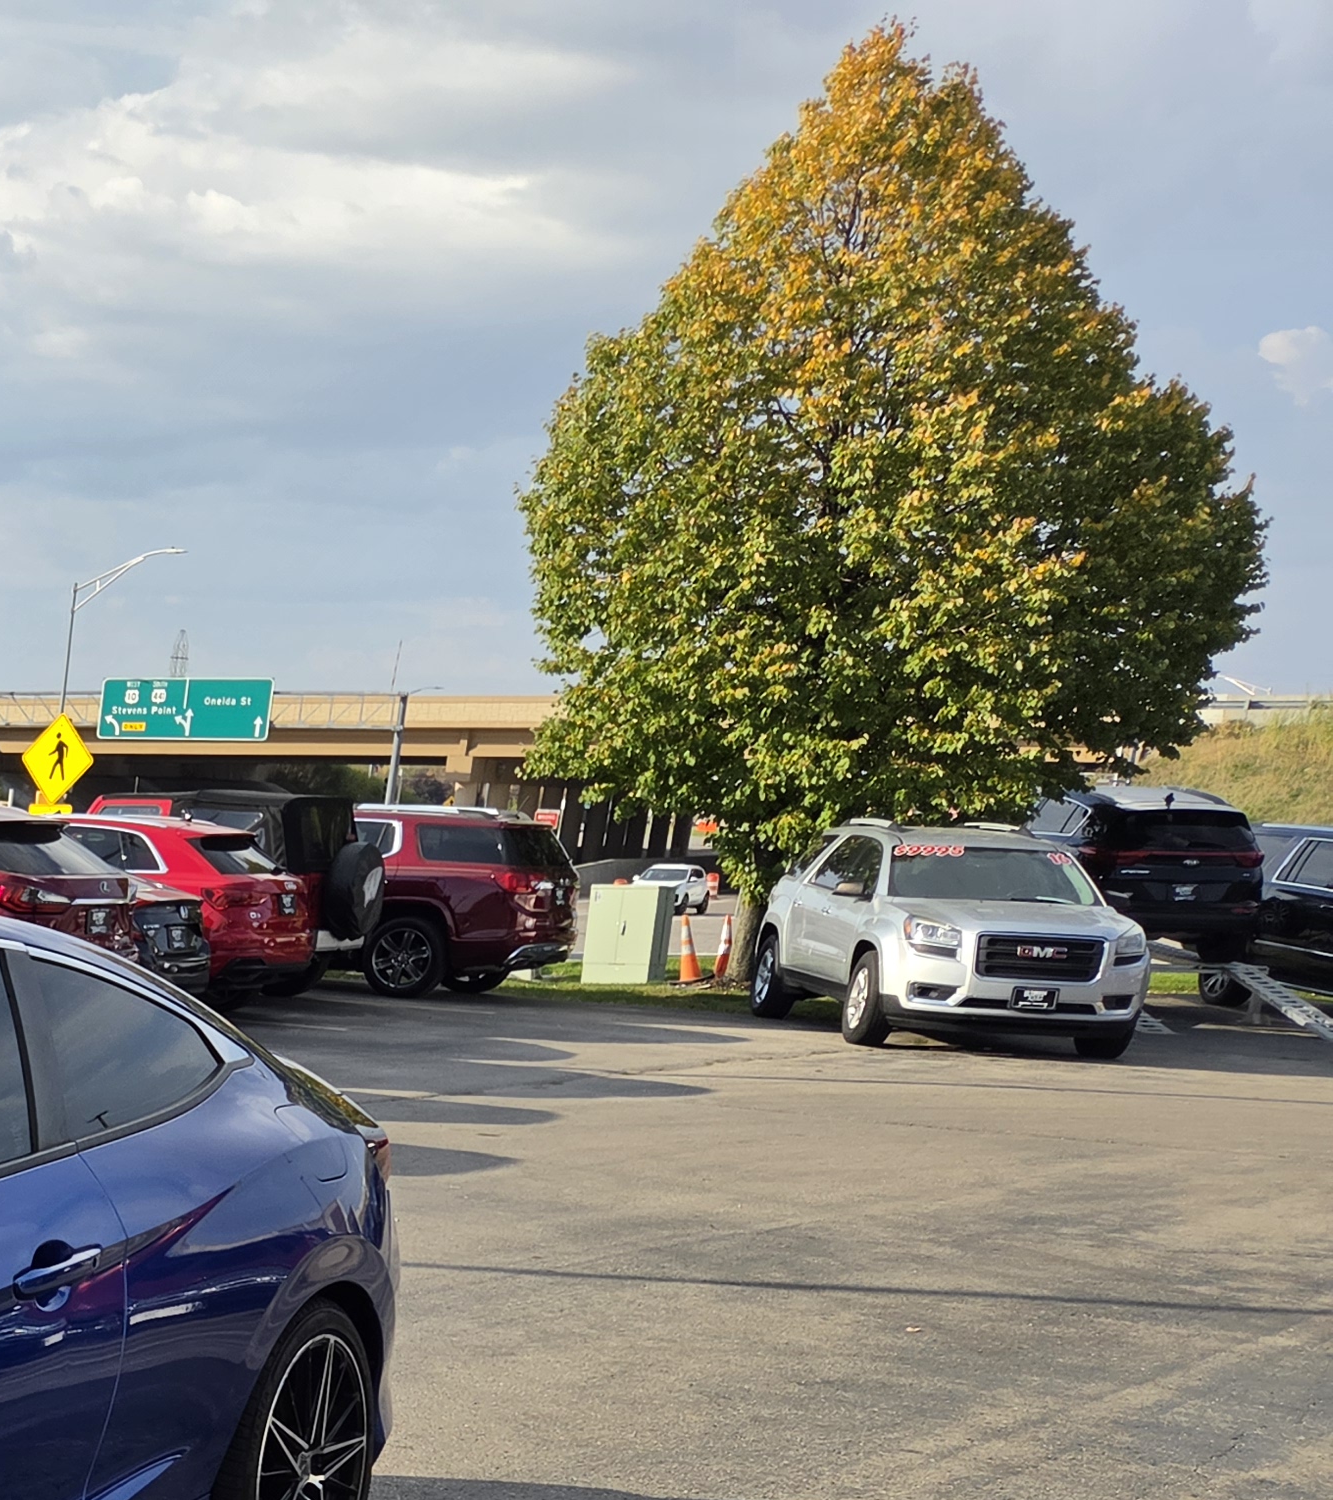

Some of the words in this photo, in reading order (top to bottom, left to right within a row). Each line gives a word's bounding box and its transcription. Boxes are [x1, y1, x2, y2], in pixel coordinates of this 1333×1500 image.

[127, 692, 137, 701] 10
[204, 696, 237, 706] Oneida
[240, 696, 252, 706] St
[112, 706, 147, 715] Stevens
[151, 706, 177, 715] Point
[1017, 946, 1068, 958] GMC
